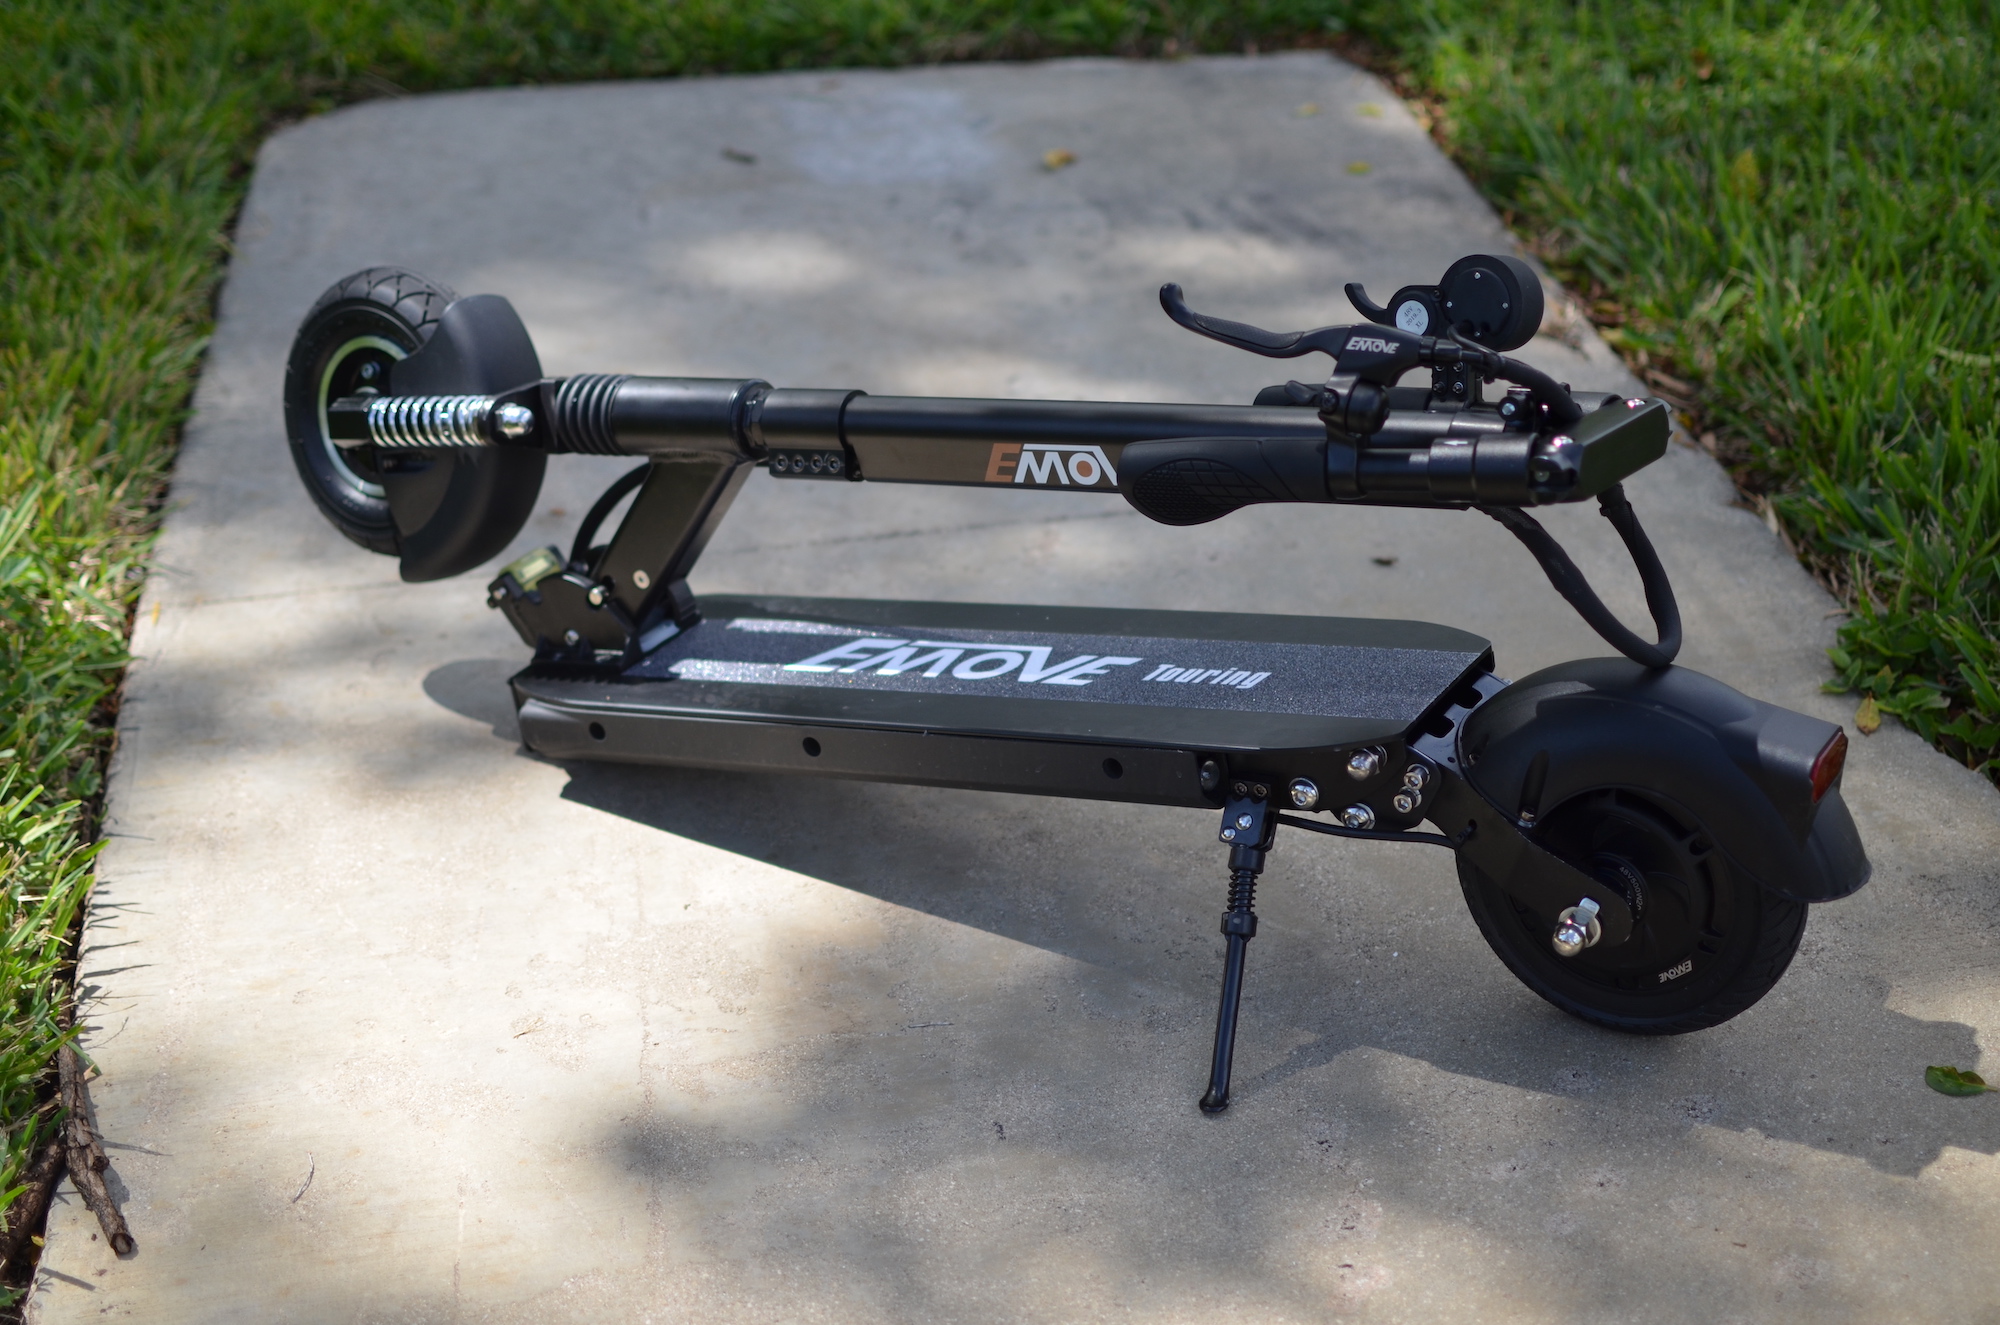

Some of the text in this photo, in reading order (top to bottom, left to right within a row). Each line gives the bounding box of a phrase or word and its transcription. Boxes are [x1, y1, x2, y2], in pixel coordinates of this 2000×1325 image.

[1345, 336, 1400, 354] EMOVE
[984, 443, 1118, 486] EMOV
[783, 638, 1273, 689] EMOVE Touring
[1658, 959, 1693, 984] EMOVE
